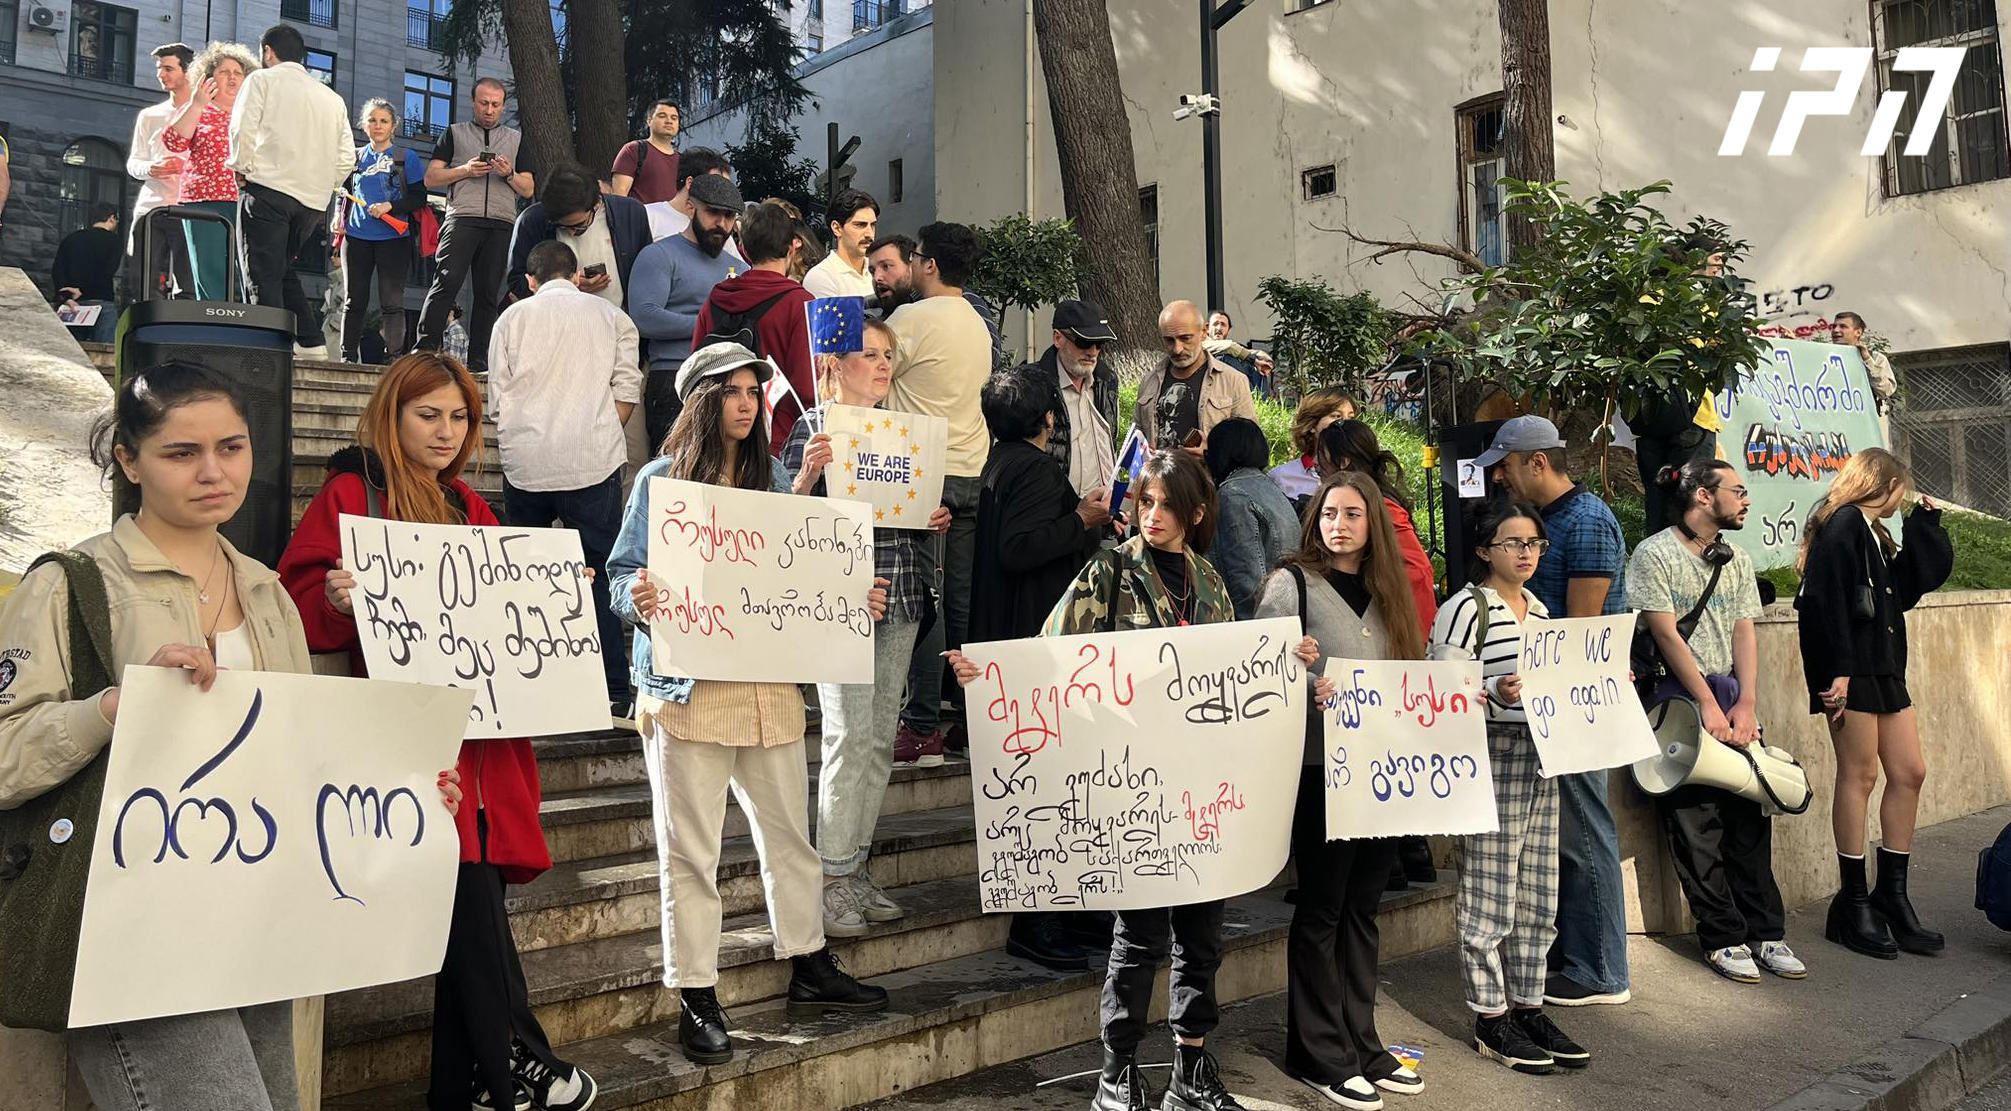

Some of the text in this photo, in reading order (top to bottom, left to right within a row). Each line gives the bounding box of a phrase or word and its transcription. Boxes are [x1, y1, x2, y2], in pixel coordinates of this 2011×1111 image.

[205, 307, 246, 318] SONY
[857, 452, 911, 470] WE ARE
[857, 468, 911, 484] EUROPE
[661, 501, 765, 567] რუსული
[655, 586, 871, 640] რუსულ მთავრობამდე
[439, 612, 495, 680] მეც
[505, 601, 601, 679] მეშინია
[1524, 626, 1611, 671] here we
[1531, 675, 1621, 739] go again
[113, 687, 278, 869] ირა
[983, 752, 1037, 800] არ
[1370, 748, 1477, 801] გავიგო
